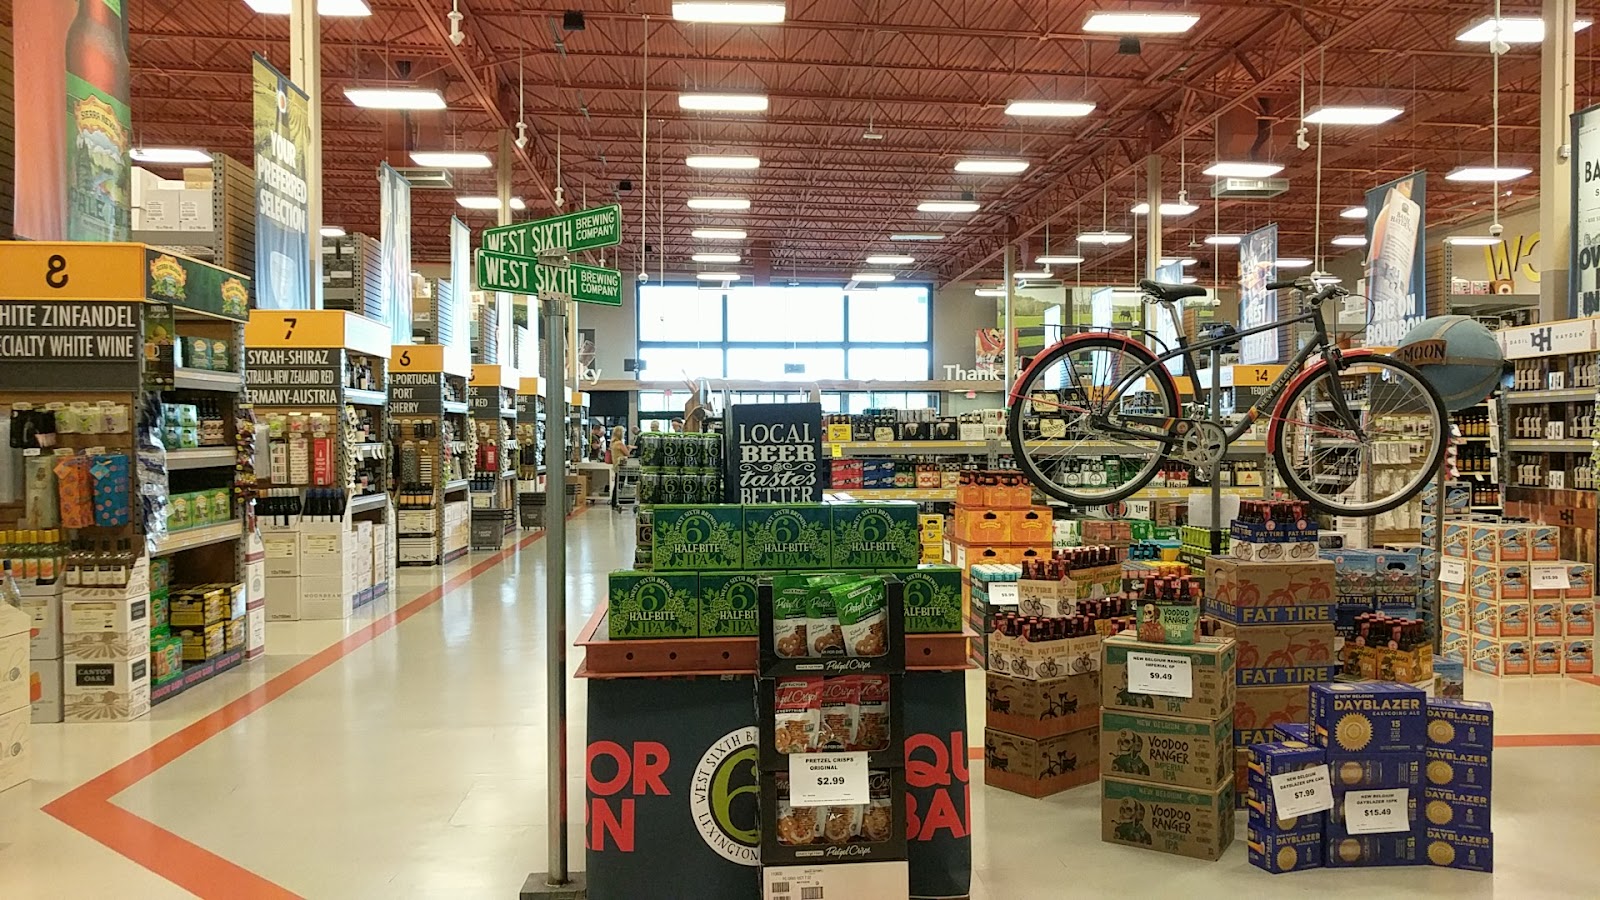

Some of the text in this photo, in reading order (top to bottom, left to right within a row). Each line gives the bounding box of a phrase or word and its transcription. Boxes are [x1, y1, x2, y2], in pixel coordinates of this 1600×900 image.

[270, 129, 297, 169] YOUR
[257, 153, 307, 205] PREFERRED
[259, 187, 306, 234] SELECTION
[575, 211, 615, 230] BREWING
[487, 220, 573, 256] WEST SIXTH
[575, 224, 615, 241] COMPANY
[46, 254, 69, 289] 8
[484, 256, 578, 296] WEST SIXTH
[580, 270, 619, 287] BREWING
[580, 282, 619, 297] COMPANY
[1374, 293, 1416, 322] BIG ON
[41, 305, 136, 327] ZINFANDEL
[283, 318, 297, 340] 7
[0, 334, 134, 358] CIALTY WHITE WINE
[1403, 343, 1446, 362] MOON
[247, 350, 329, 365] SYRAH-SHIRAZ
[399, 350, 411, 367] 6
[289, 369, 320, 384] ZEALAND
[320, 369, 334, 384] RED
[943, 363, 1001, 381] Thank
[1255, 369, 1268, 382] 14
[1258, 361, 1301, 409] NEW BELGIUM
[393, 388, 414, 399] PORT
[389, 402, 420, 413] SHERRY
[474, 398, 488, 407] RED
[739, 423, 816, 444] LOCAL
[739, 444, 817, 463] BEER
[739, 471, 817, 488] tastes
[739, 486, 813, 504] BETTER
[1135, 504, 1148, 513] Lite
[1268, 530, 1284, 538] TIRE
[687, 553, 708, 565] IPA
[777, 553, 798, 565] IPA
[863, 551, 885, 563] IPA
[1163, 608, 1190, 617] VOODOO
[1206, 598, 1236, 616] FAT TIRE
[1243, 606, 1329, 622] FAT TIRE
[641, 620, 664, 633] IPA
[732, 620, 753, 632] IPA
[908, 617, 930, 629] IPA
[1163, 616, 1190, 625] RANGER
[1171, 630, 1181, 638] IPA
[1149, 672, 1173, 681] $9.49
[1241, 668, 1328, 684] FAT TIRE
[1167, 701, 1182, 713] IPA
[1334, 699, 1420, 711] DAYBLAZER
[1427, 709, 1490, 722] DAYBLAZER
[1390, 720, 1401, 728] 15
[1148, 735, 1189, 752] VOODOO
[1240, 730, 1274, 745] FAT
[1149, 748, 1190, 765] RANGER
[1426, 751, 1488, 763] DAYBLAZER
[585, 740, 671, 796] OR
[694, 734, 742, 804] WEST SIXTH
[816, 777, 845, 786] $2.99
[1297, 772, 1316, 780] BELGIUM
[1294, 788, 1315, 799] $7.99
[1425, 791, 1488, 804] DAYBLAZER
[1150, 804, 1191, 821] VOODOO
[1364, 808, 1392, 818] $15.49
[1151, 817, 1192, 834] RANGER
[698, 812, 759, 861] LEXINGTON
[1276, 832, 1321, 846] DAYBLAZER
[1427, 831, 1490, 845] DAYBLAZER
